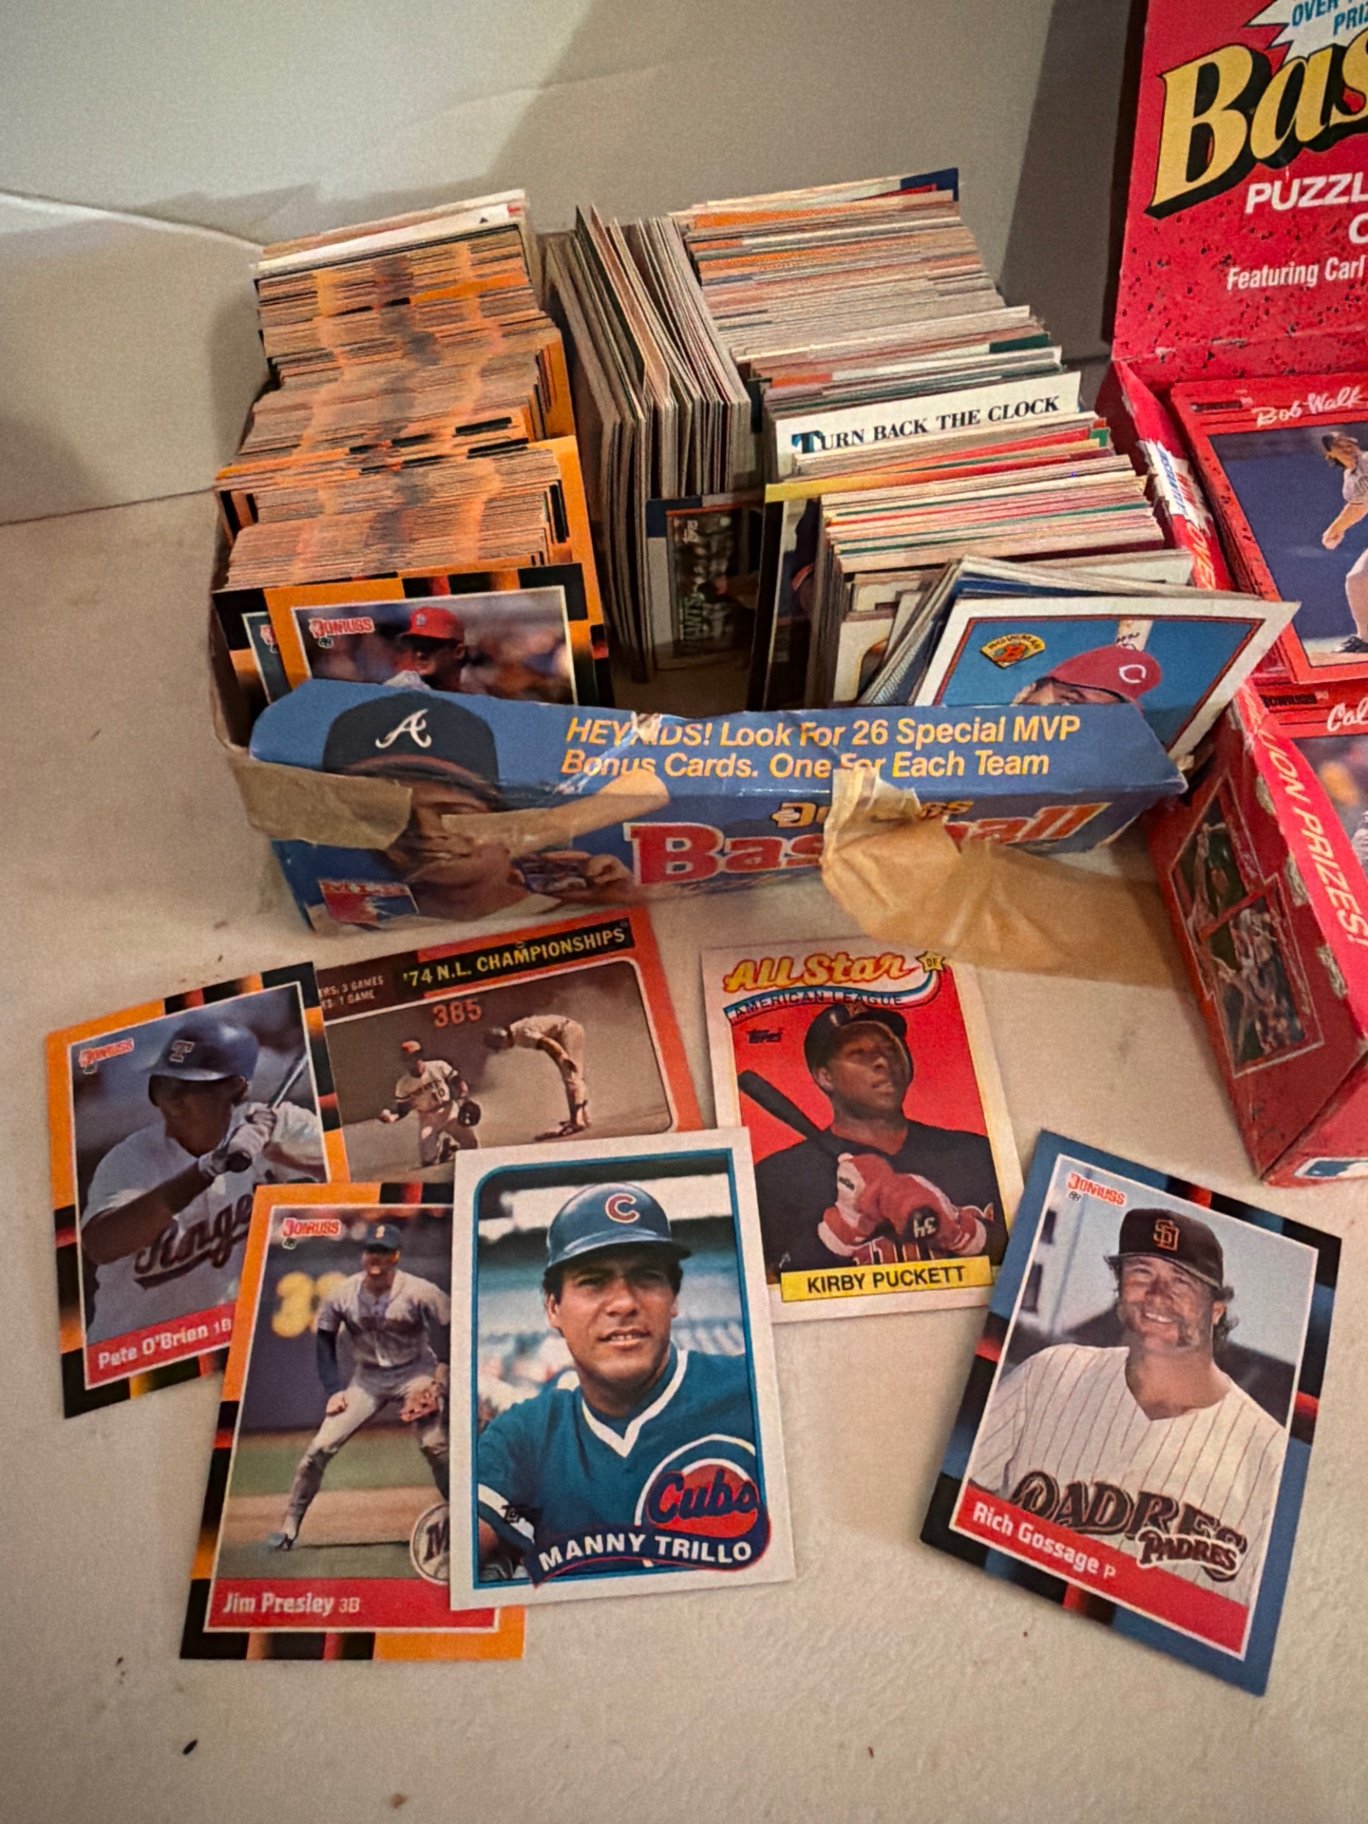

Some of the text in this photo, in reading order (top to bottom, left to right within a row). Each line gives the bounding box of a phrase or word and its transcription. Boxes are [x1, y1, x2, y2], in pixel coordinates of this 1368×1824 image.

[1333, 3, 1368, 36] PRI
[1227, 255, 1365, 290] Featuring Carl
[791, 396, 1060, 454] TURN BACK THE CLOCK
[1251, 401, 1302, 427] Bob
[375, 708, 432, 749] A
[565, 716, 632, 747] HEY
[720, 720, 793, 747] Look
[799, 720, 847, 747] For
[852, 719, 888, 746] 26
[895, 717, 1004, 748] Special
[1012, 716, 1080, 742] MVP
[561, 748, 656, 778] Bonus
[664, 751, 759, 779] Cards.
[769, 752, 831, 779] One
[892, 750, 966, 778] Each
[976, 750, 1050, 776] Team
[1293, 806, 1368, 947] PRIZES!
[402, 927, 626, 988] '74 N.L. CHAMPIONSHIPS
[800, 951, 920, 986] Star
[735, 991, 903, 1019] AMERICAN LEAGUE
[605, 1193, 641, 1224] C
[807, 1265, 966, 1294] KIRBY PUCKETT
[98, 1346, 138, 1370] Pete
[141, 1323, 209, 1355] O'Brien
[538, 1532, 753, 1572] MANNY TRILLO
[972, 1501, 1117, 1580] Rich Gossage P
[222, 1591, 360, 1617] Jim Presley 3B
